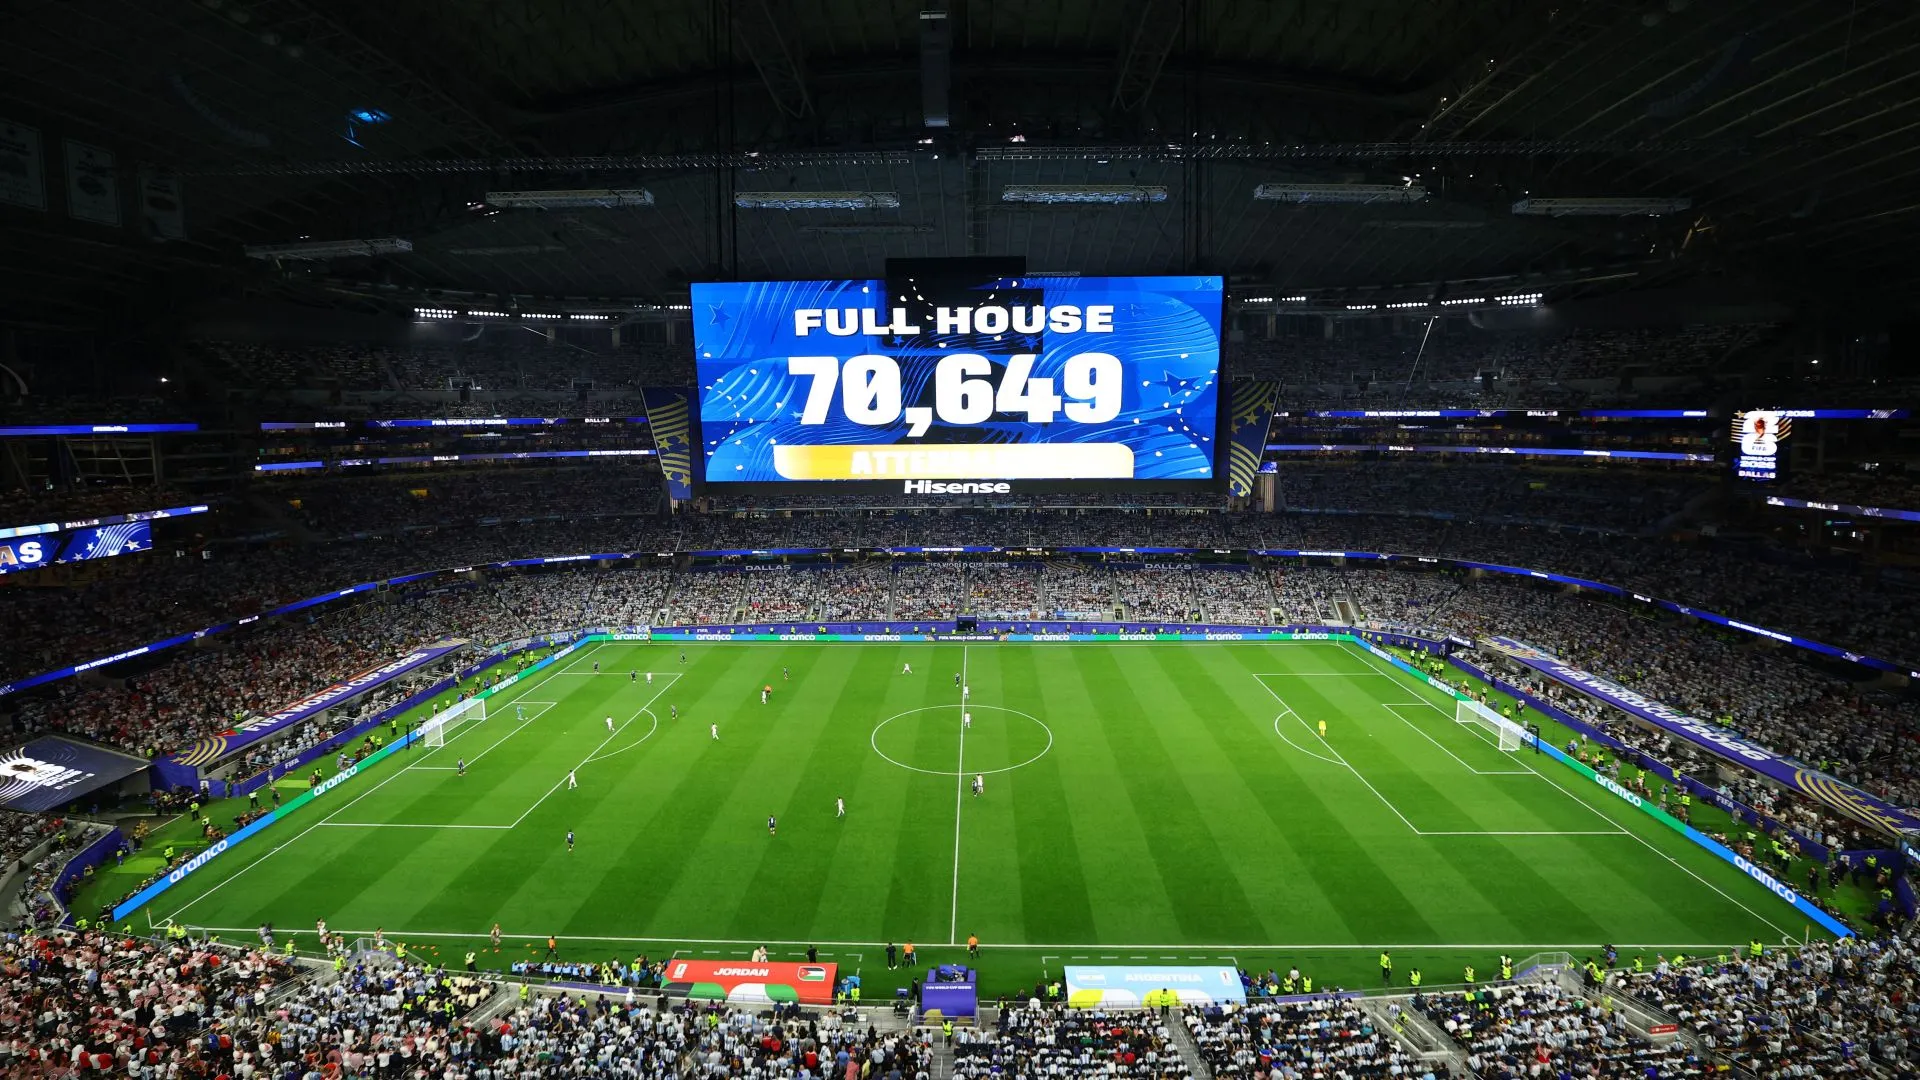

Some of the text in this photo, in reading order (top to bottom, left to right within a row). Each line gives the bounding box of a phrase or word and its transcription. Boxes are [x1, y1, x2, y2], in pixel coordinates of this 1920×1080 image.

[794, 305, 1114, 336] FULL HOUSE
[788, 353, 1123, 437] 70,649
[1739, 460, 1776, 469] 2026
[1738, 470, 1776, 479] DALLAS
[904, 479, 1011, 494] Hisense
[64, 518, 101, 531] DALLAS
[745, 563, 792, 572] DALLAS
[1144, 562, 1192, 571] DALLAS
[1205, 633, 1243, 641] aramco
[1291, 633, 1329, 641] aramco
[1370, 646, 1393, 662] aramco
[491, 674, 519, 694] aramco
[1427, 676, 1456, 697] aramco
[245, 713, 295, 732] FIFA
[297, 685, 353, 713] WORLD
[348, 671, 381, 688] CUP
[1551, 666, 1588, 682] FIFA
[1583, 680, 1650, 709] WORLD
[1644, 706, 1692, 726] CUP
[285, 757, 300, 770] FIFA
[313, 764, 358, 798] aramco
[1594, 772, 1642, 808] aramco
[1715, 794, 1735, 809] FIFA
[168, 838, 229, 884] aramco
[1733, 855, 1797, 905] aramco
[712, 967, 769, 977] JORDAN
[1124, 973, 1204, 983] ARGENTINA
